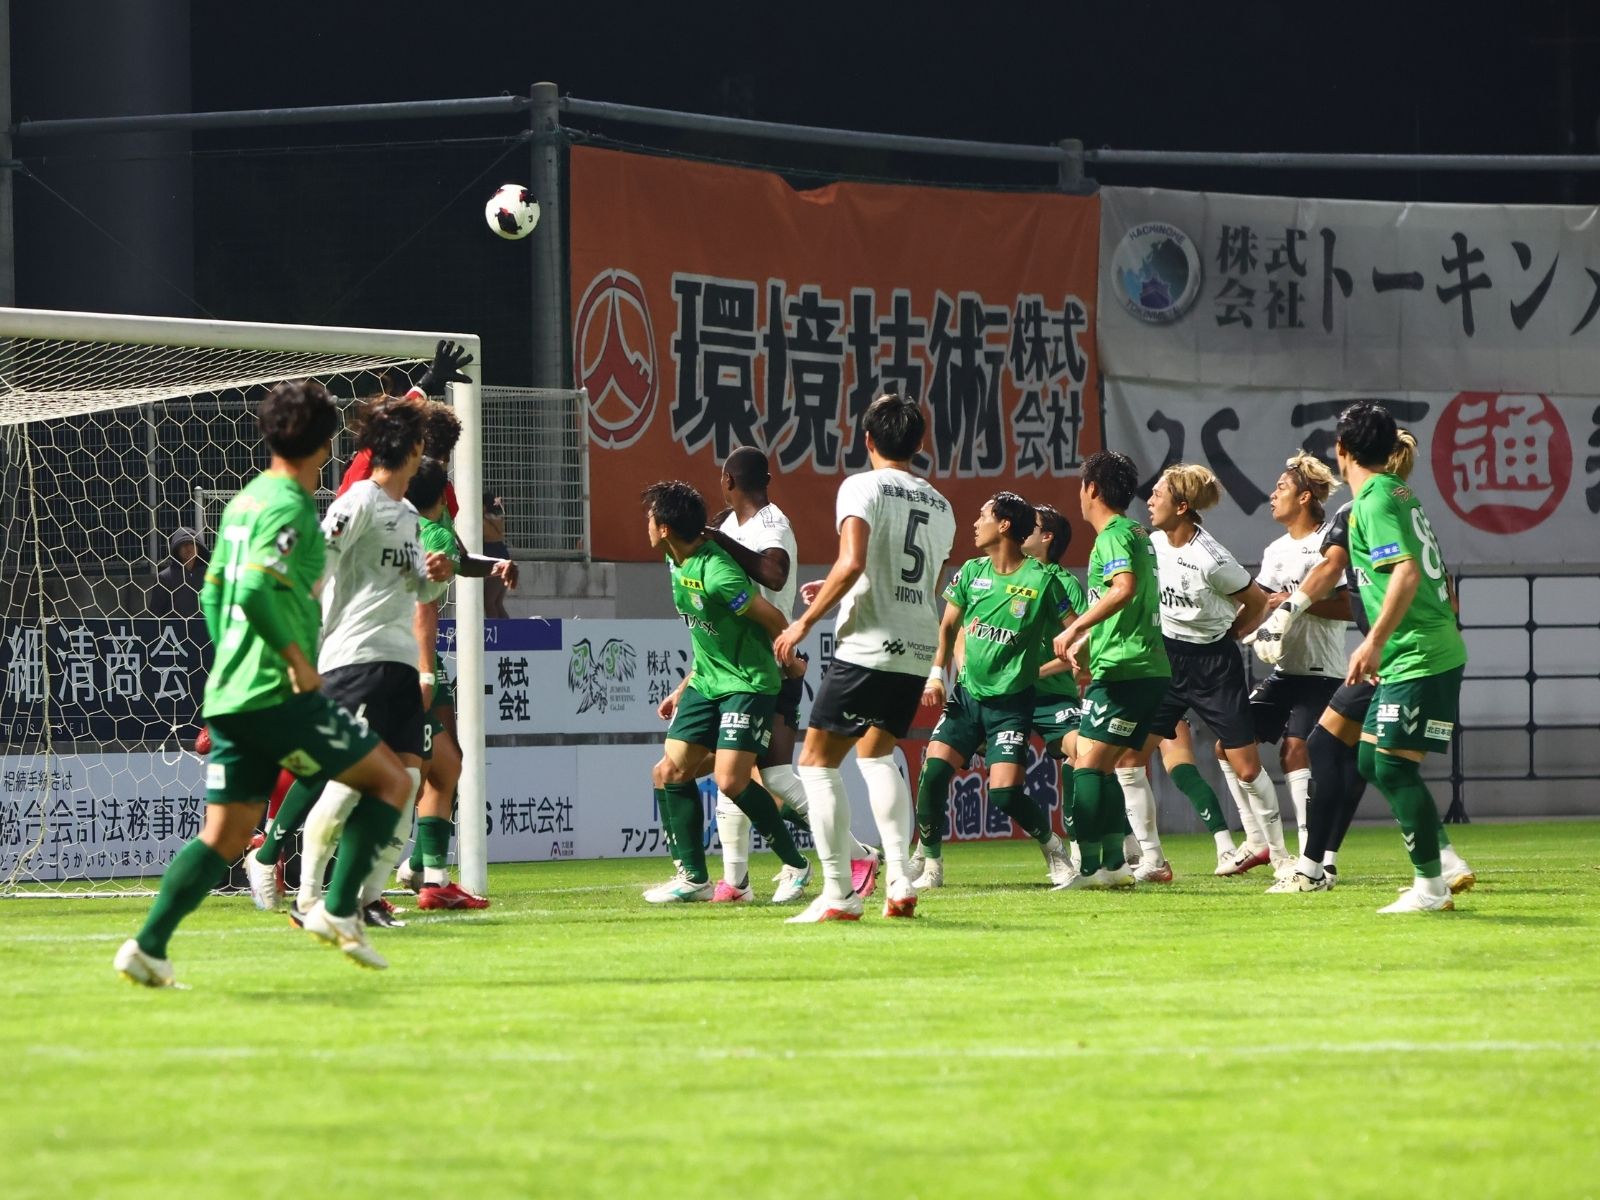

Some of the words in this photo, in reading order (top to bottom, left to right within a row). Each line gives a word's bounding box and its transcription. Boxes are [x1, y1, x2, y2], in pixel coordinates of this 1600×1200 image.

[1215, 225, 1307, 277] 株式
[1215, 278, 1305, 329] 会社
[1010, 295, 1088, 388] 株式
[671, 273, 1011, 477] 環境技術
[1014, 388, 1085, 477] 会社
[901, 508, 930, 584] 5
[8, 625, 189, 703] 細清商会
[498, 656, 529, 688] 株式
[647, 650, 671, 676] 株式
[4, 722, 84, 736] HOSSEI
[499, 690, 530, 722] 会社
[0, 796, 208, 845] 総合会計法務事務
[500, 796, 574, 836] 株式会社
